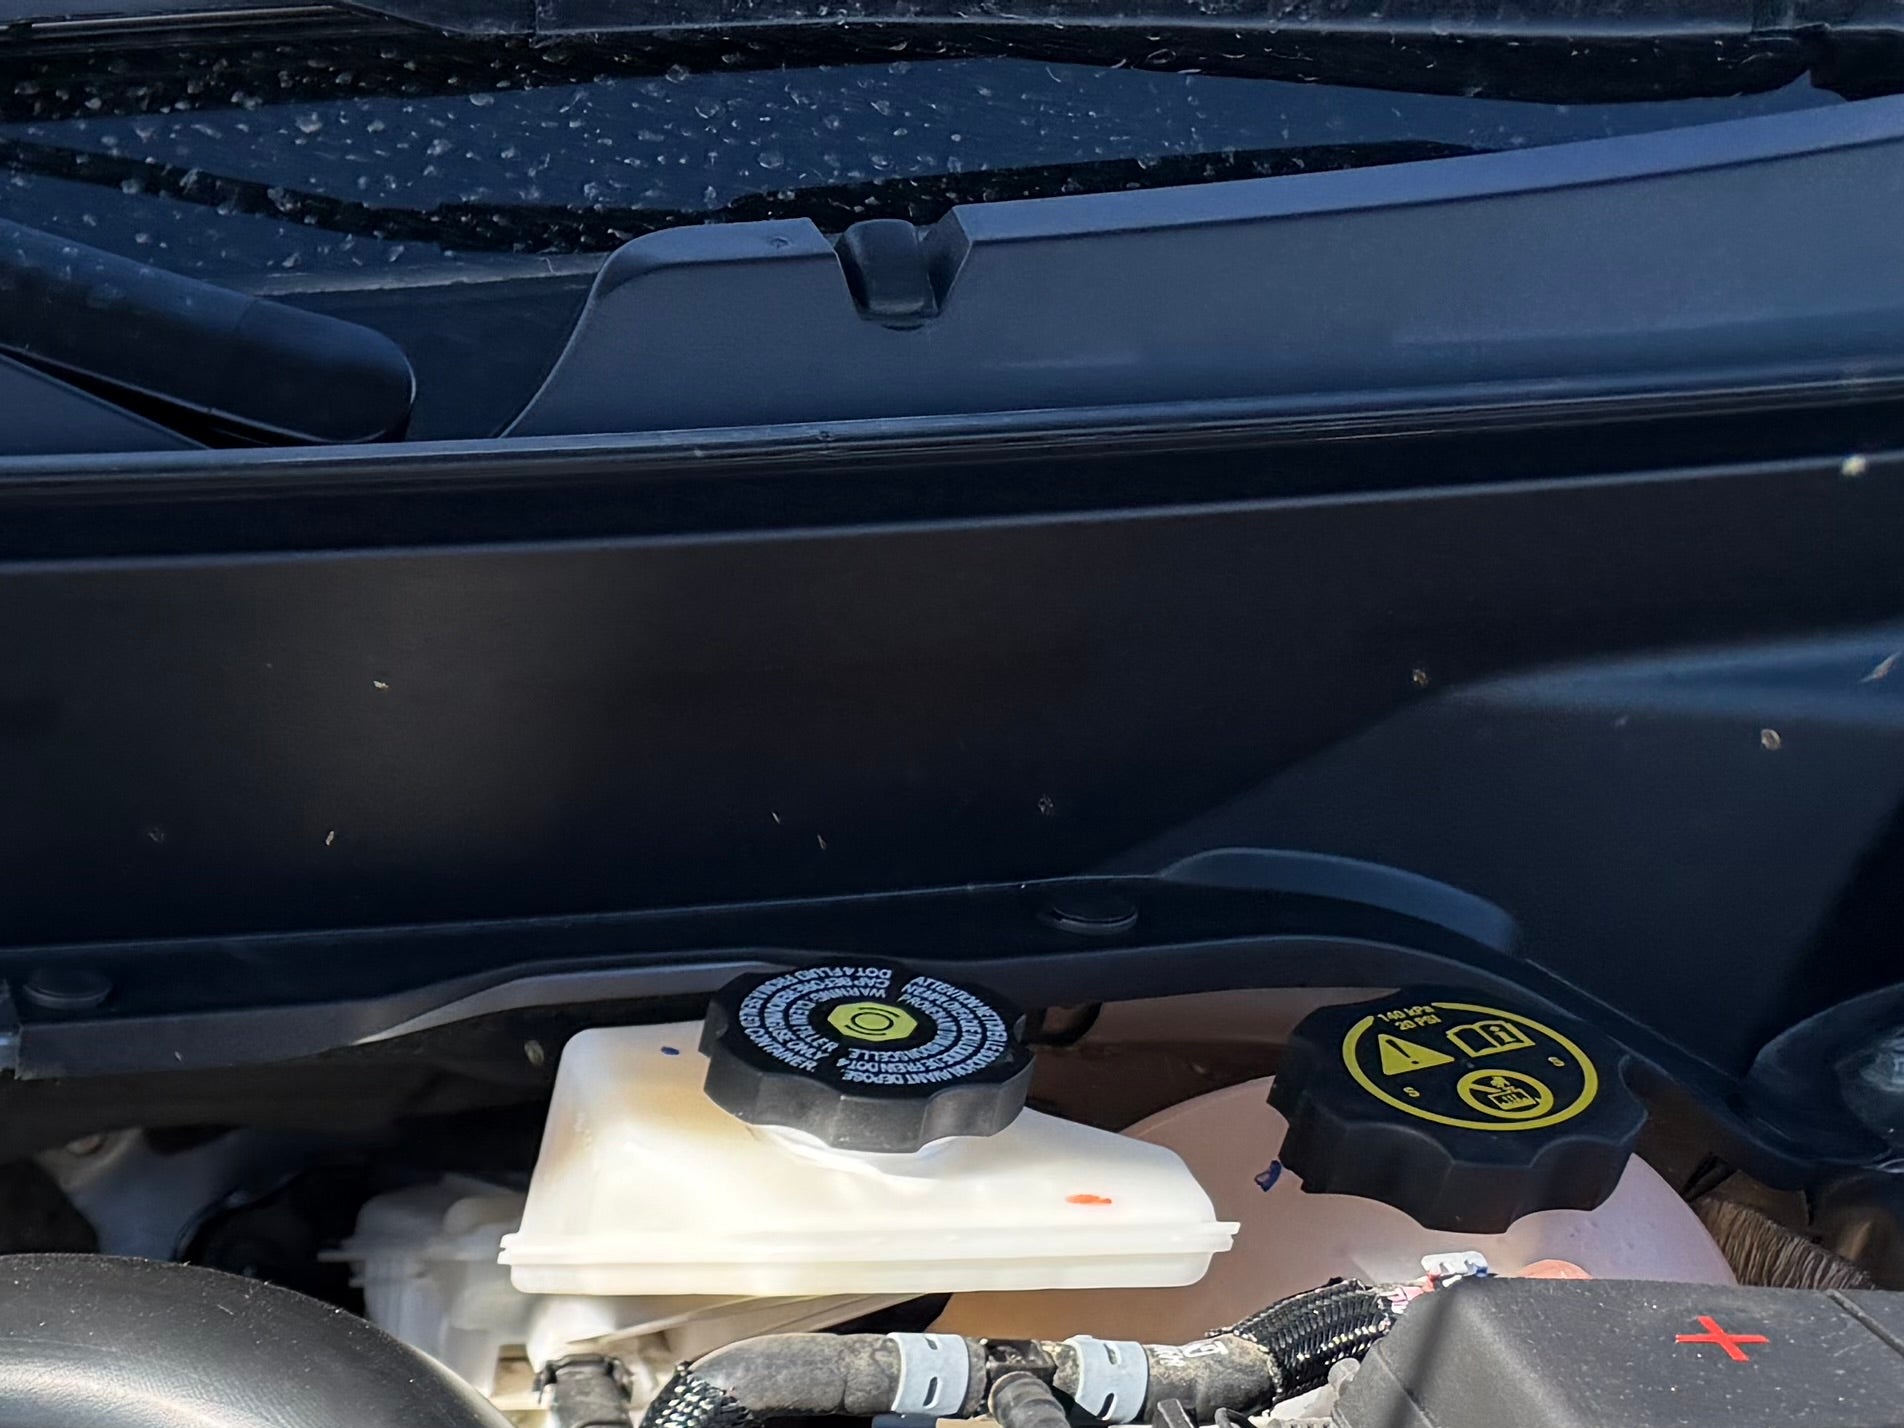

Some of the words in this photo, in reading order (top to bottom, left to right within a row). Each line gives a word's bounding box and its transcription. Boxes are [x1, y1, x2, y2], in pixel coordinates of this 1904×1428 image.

[793, 967, 842, 980] FLUID
[855, 967, 890, 978] DOT
[790, 977, 852, 994] BEFORE
[852, 977, 889, 988] CAP
[1377, 1007, 1405, 1023] 140
[1404, 1004, 1435, 1018] kPa
[1394, 1018, 1416, 1031] 20
[1416, 1014, 1442, 1028] PSI
[782, 1040, 827, 1061] ONLY
[847, 1061, 878, 1072] DOT
